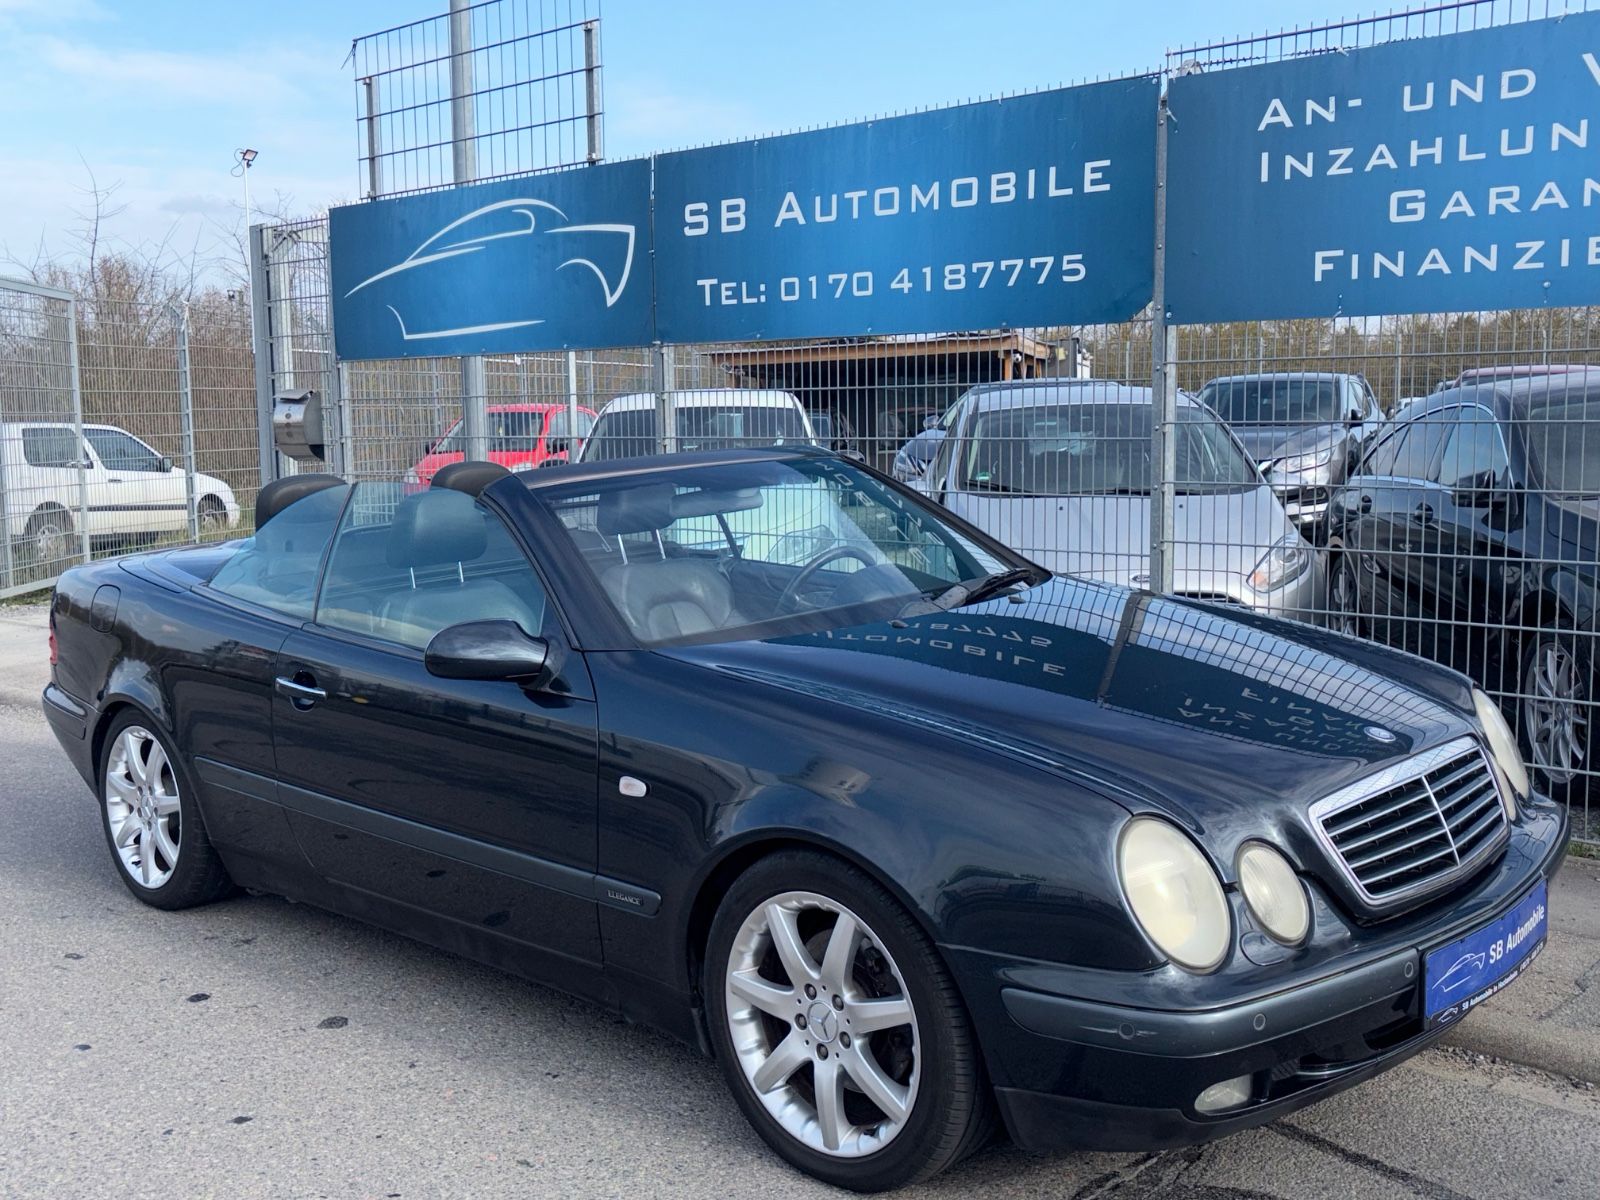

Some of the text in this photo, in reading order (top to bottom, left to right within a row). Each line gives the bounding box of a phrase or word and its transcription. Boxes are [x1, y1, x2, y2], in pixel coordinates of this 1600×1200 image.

[1257, 95, 1362, 131] AN-
[1403, 68, 1536, 113] UND
[1260, 119, 1589, 183] INZAHLUN
[683, 159, 1111, 237] SB AUTOMOBILE
[780, 270, 874, 302] 0170
[890, 253, 1086, 294] 4187775
[607, 889, 640, 905] ELEGANCE
[1489, 939, 1504, 964] SB
[1506, 903, 1545, 954] Automobile
